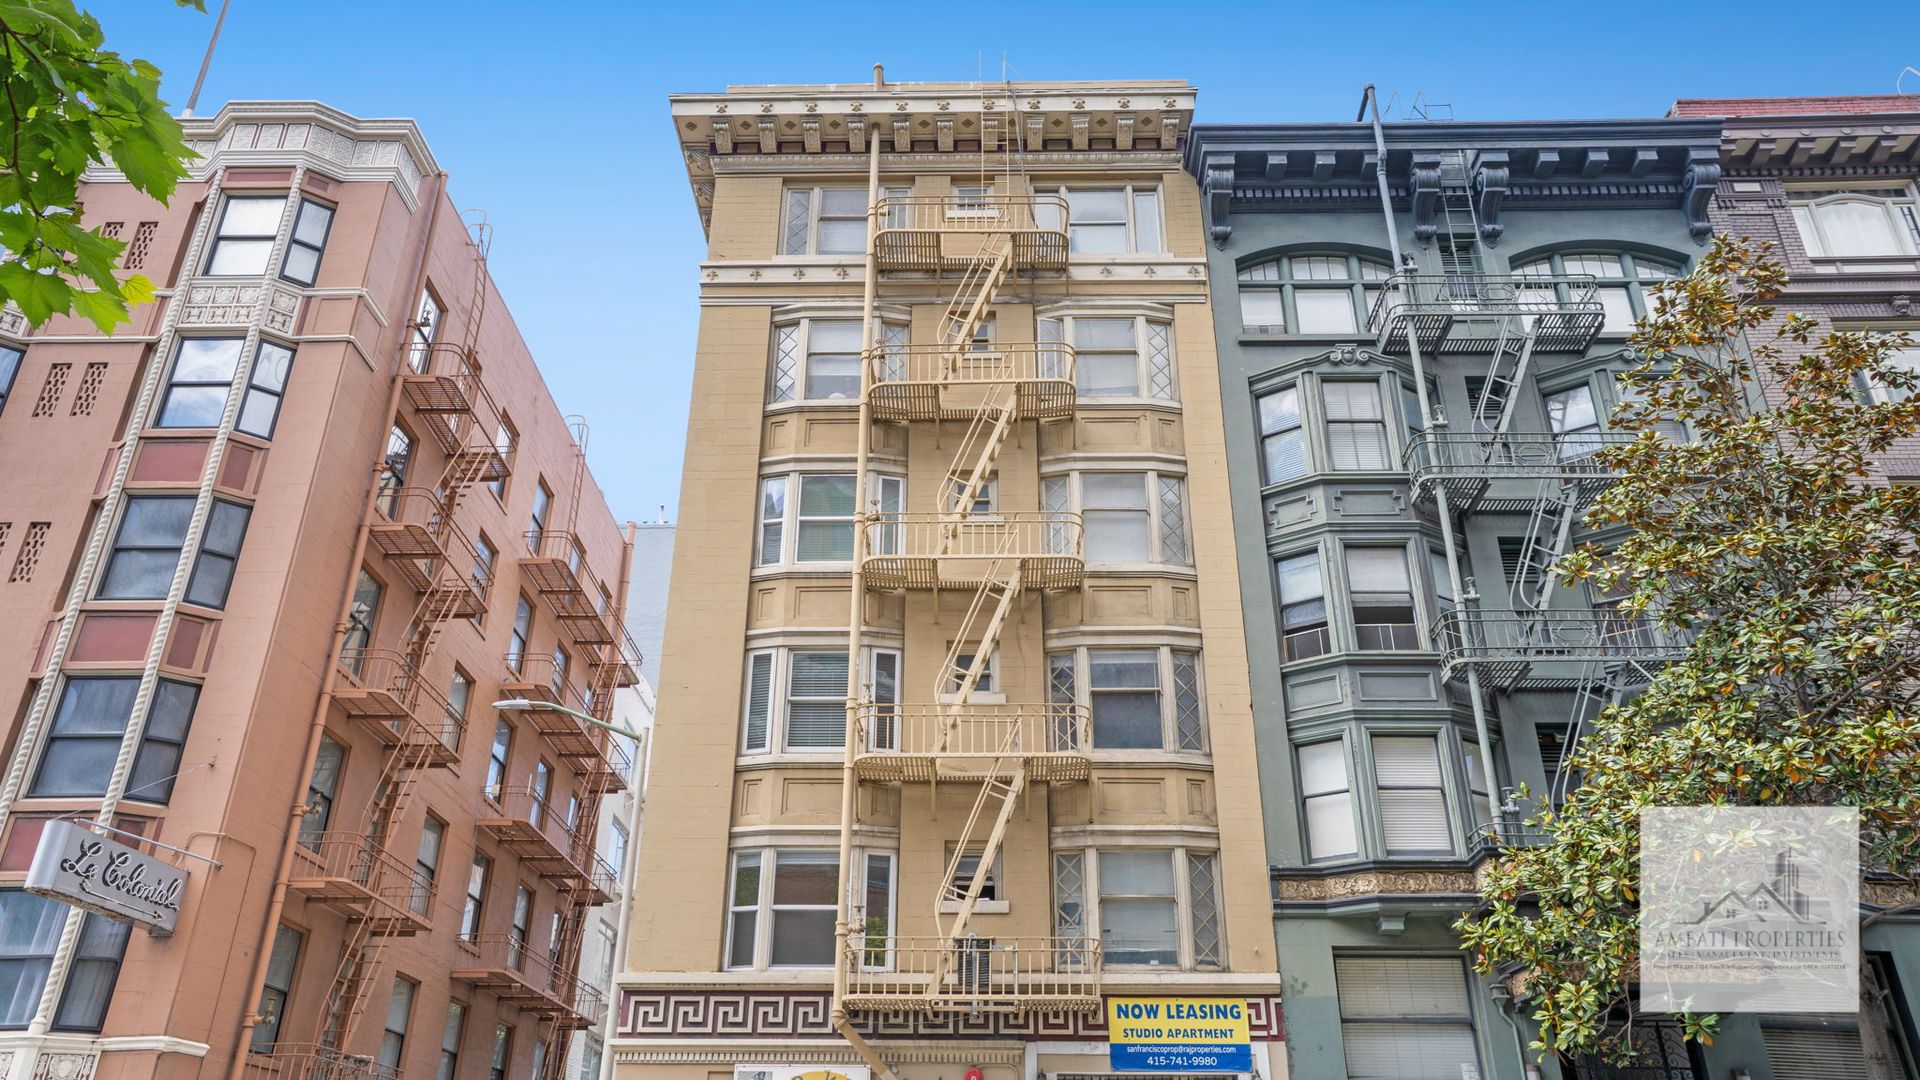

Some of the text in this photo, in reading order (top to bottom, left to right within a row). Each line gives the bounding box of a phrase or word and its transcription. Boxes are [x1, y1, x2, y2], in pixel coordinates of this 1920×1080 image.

[102, 850, 183, 912] Colonial
[1116, 1003, 1242, 1020] NOW LEASING
[1123, 1028, 1235, 1039] STUDIO APARTMENT
[1146, 1056, 1218, 1066] 415-741-9980
